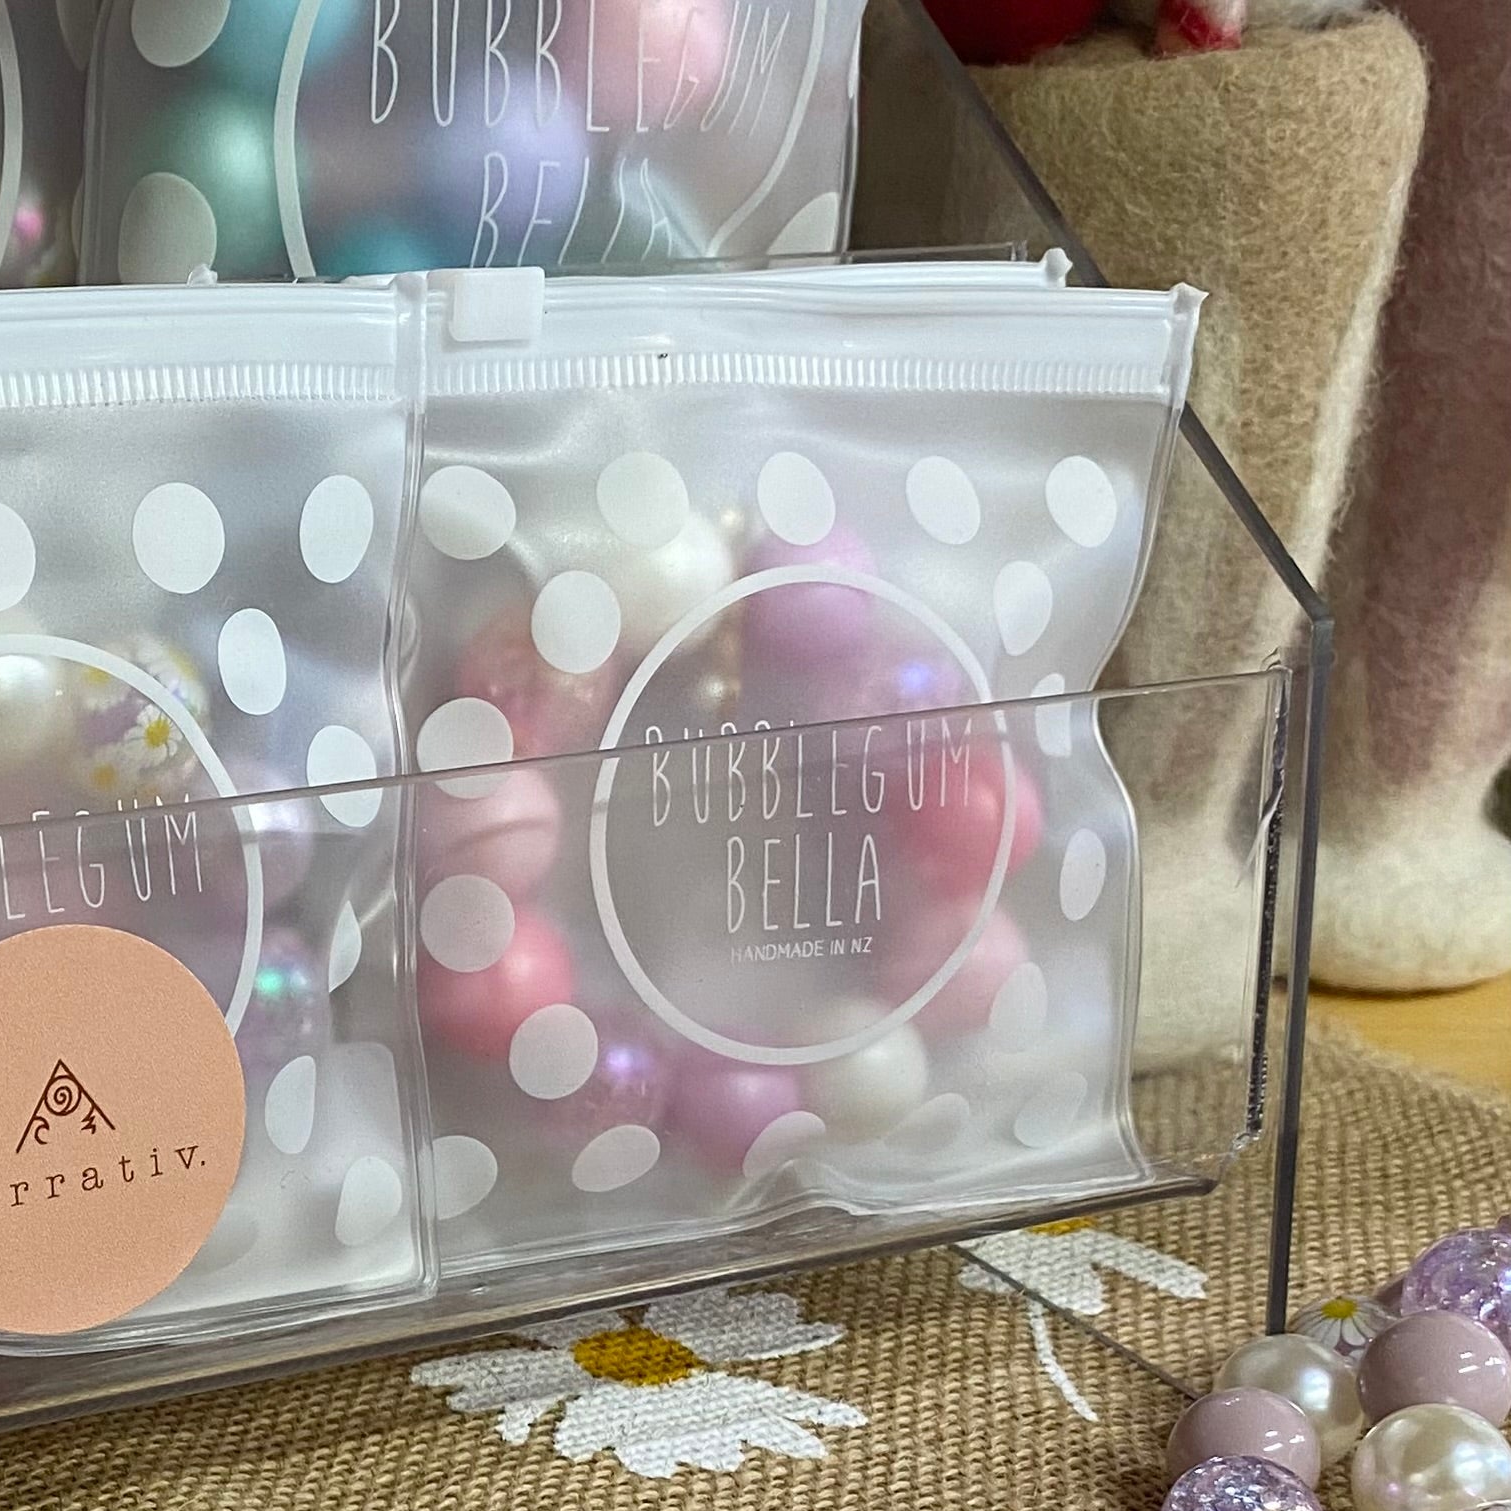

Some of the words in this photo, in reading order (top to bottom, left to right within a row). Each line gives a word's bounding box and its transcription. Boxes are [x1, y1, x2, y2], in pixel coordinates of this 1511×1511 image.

[371, 0, 790, 137] BUBBLEGUM
[644, 717, 973, 827] BUBBLEGUM
[726, 831, 882, 934] BELLA
[731, 940, 825, 965] HANDMADE
[830, 938, 846, 956] IN
[851, 936, 873, 954] NZ
